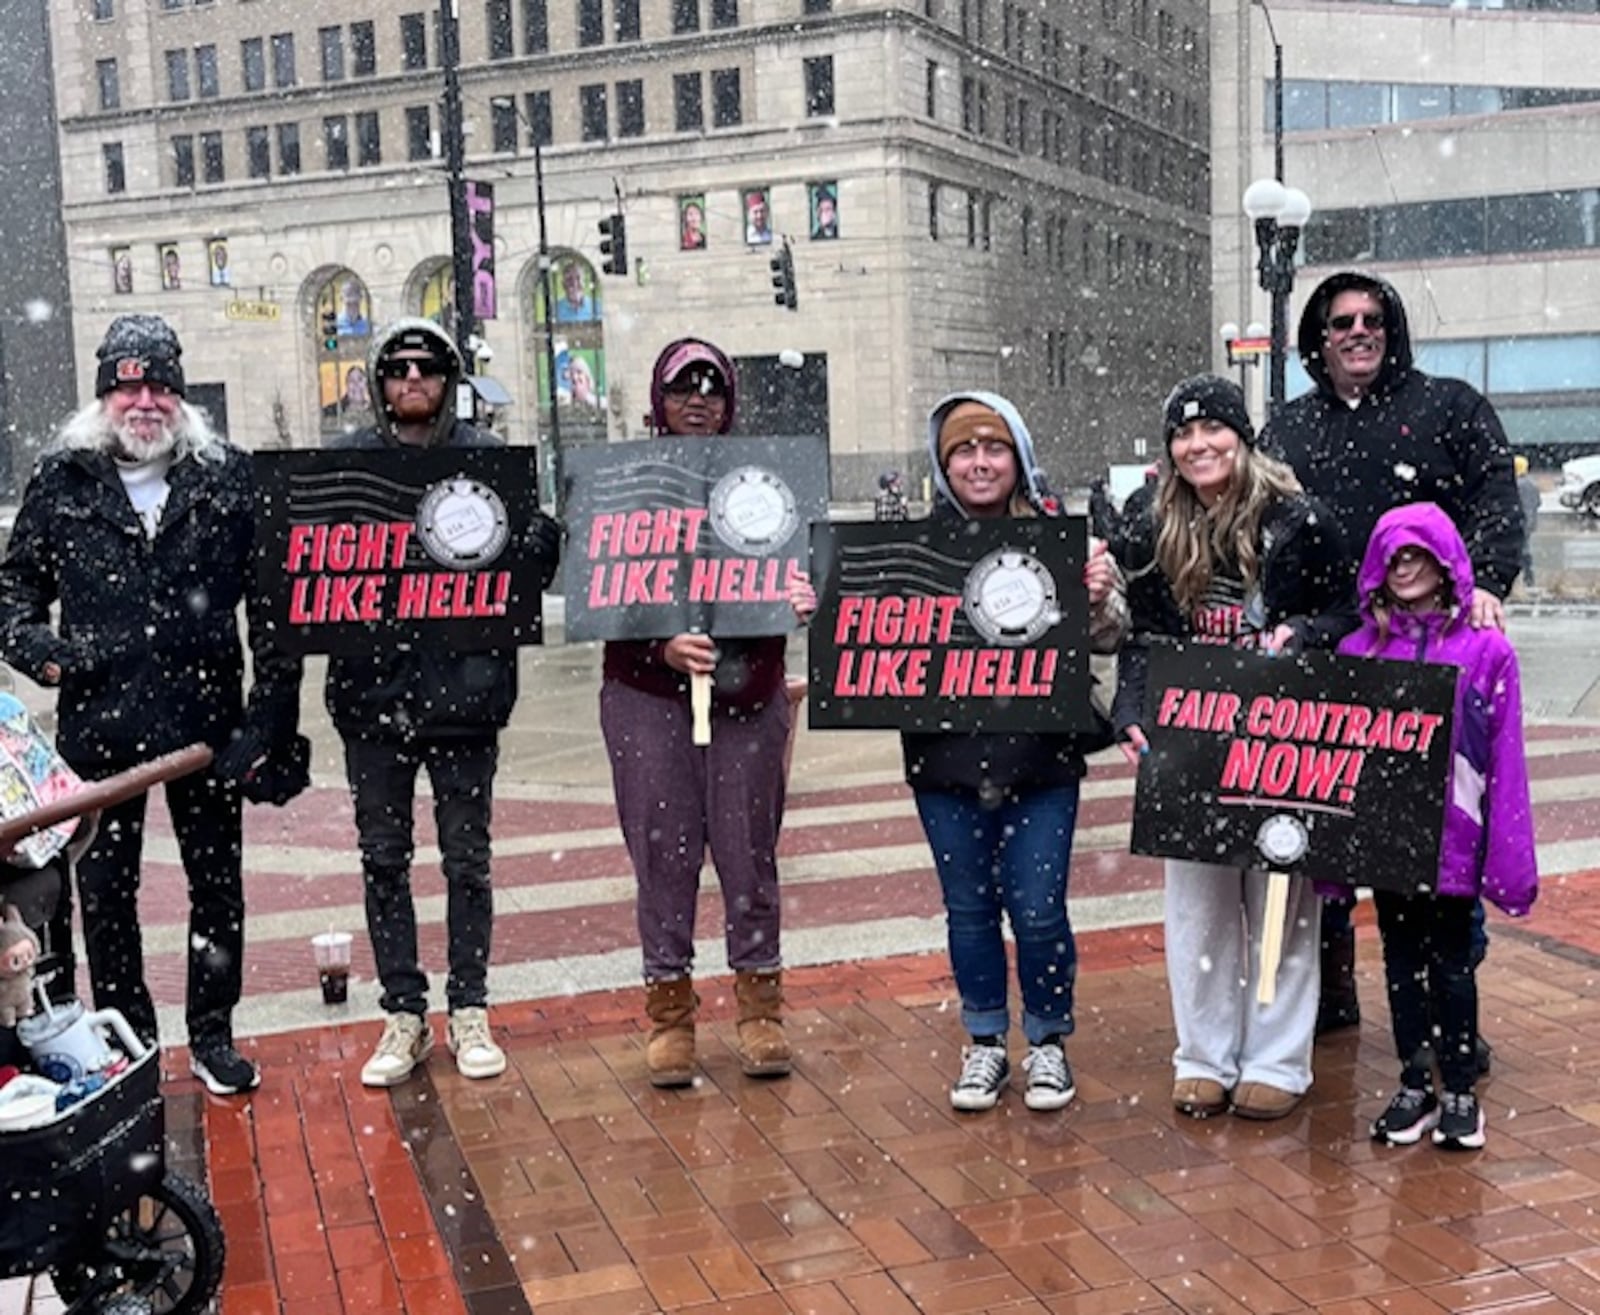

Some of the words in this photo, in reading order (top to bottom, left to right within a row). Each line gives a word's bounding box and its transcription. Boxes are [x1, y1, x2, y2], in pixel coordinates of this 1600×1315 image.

[286, 523, 415, 573] FIGHT
[590, 508, 708, 560] FIGHT
[289, 575, 388, 623] LIKE
[398, 572, 511, 617] HELL!
[588, 560, 678, 610] LIKE
[834, 596, 963, 646] FIGHT
[834, 650, 931, 696] LIKE
[940, 649, 1058, 696] HELL!
[1157, 688, 1240, 732] FAIR
[1247, 696, 1442, 752] CONTRACT
[1221, 741, 1365, 802] NOW!
